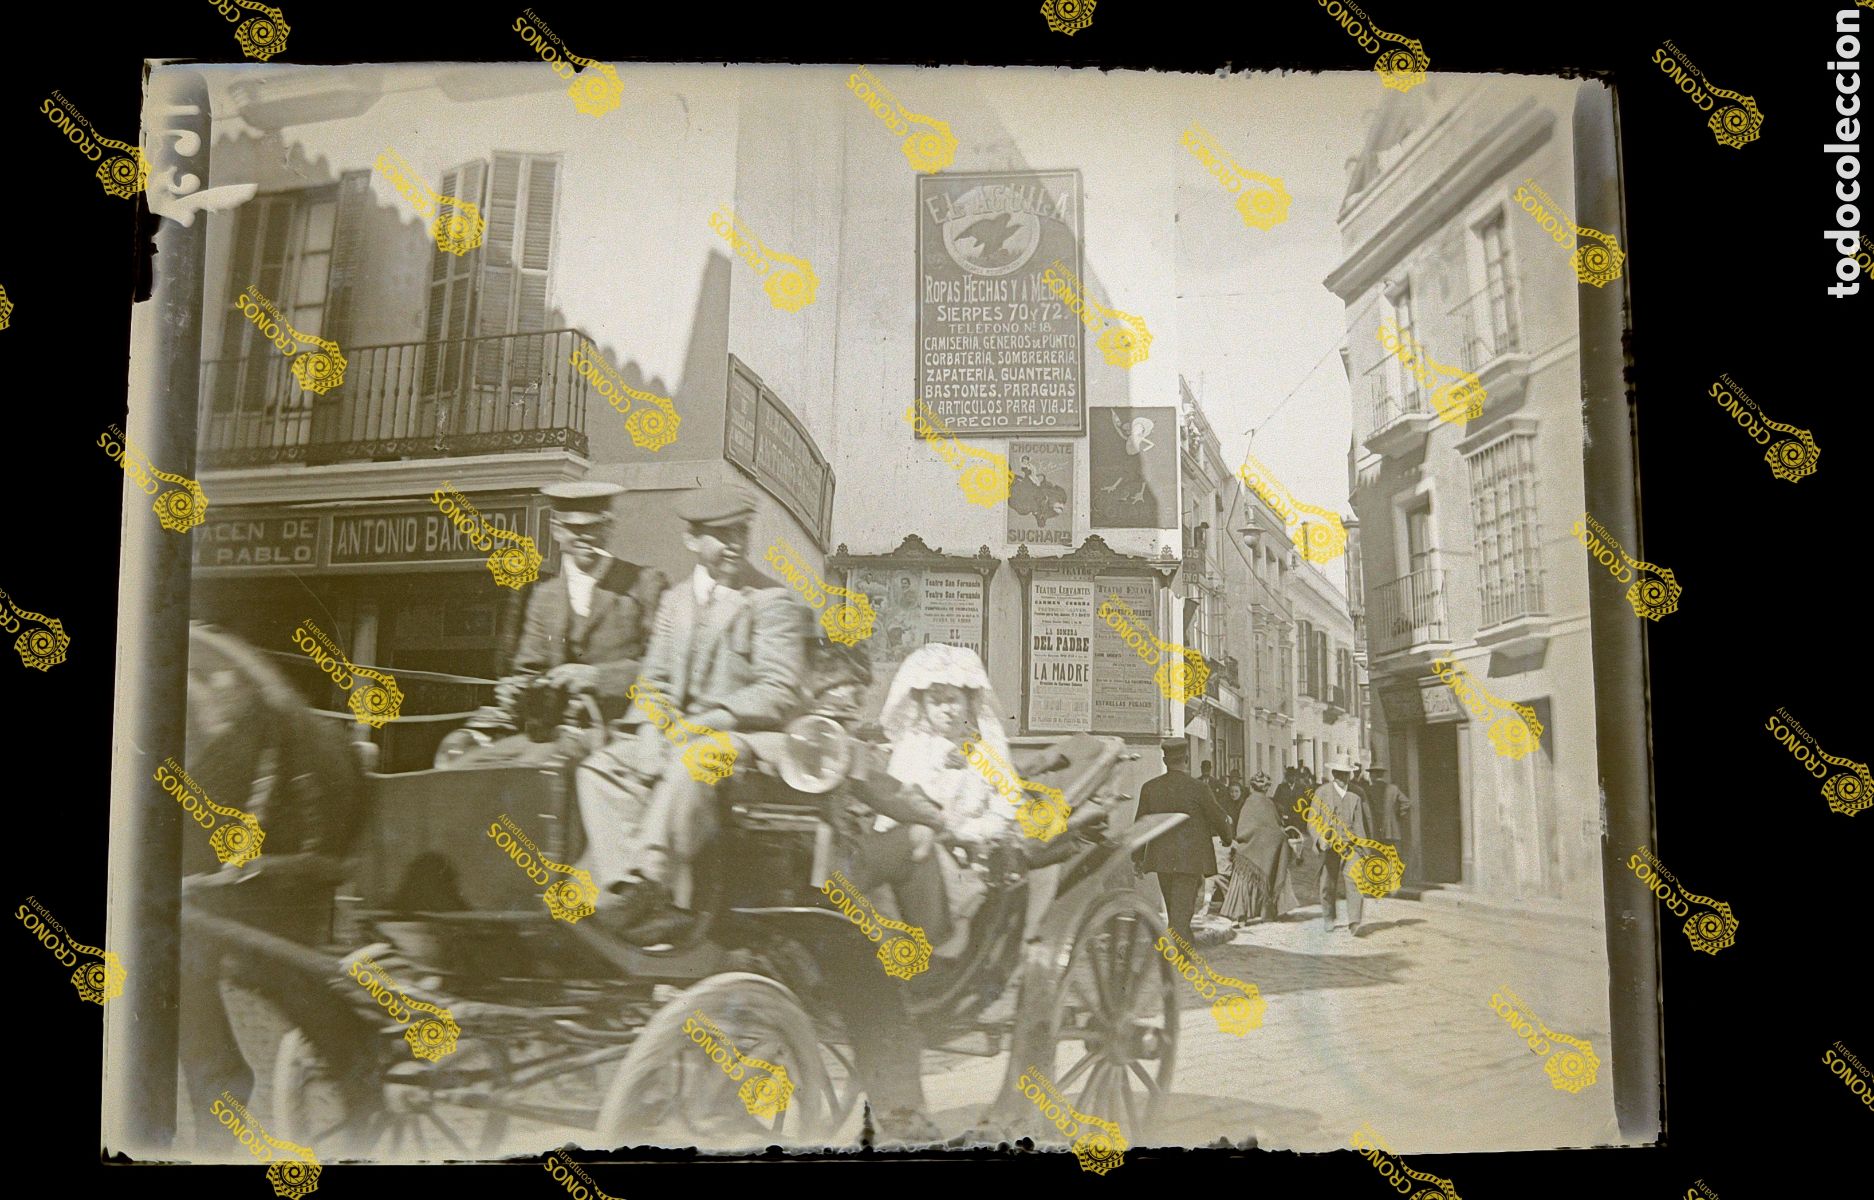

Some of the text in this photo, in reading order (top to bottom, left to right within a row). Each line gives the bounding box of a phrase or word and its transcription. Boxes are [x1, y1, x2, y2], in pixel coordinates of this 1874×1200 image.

[924, 192, 966, 225] EL
[925, 274, 960, 304] ROPAS
[962, 273, 1007, 304] HECHAS
[1011, 280, 1017, 302] Y
[1021, 280, 1027, 302] A
[937, 305, 1003, 322] SIERPES
[1008, 303, 1028, 322] 70
[1004, 383, 1075, 397] PARAGUAS
[926, 400, 933, 415] Y
[1006, 399, 1036, 414] PARA
[944, 415, 1056, 428] PRECIO FIJO
[1011, 442, 1072, 455] CHOCOLATE
[283, 521, 314, 538] DE
[337, 516, 417, 556] ANTONIO
[1009, 528, 1071, 544] SUCHARD
[217, 546, 312, 562] PABLO
[925, 578, 980, 588] Teatro San Fernando
[925, 590, 980, 599] Teatro San Fernando
[949, 629, 960, 639] EL
[1033, 635, 1089, 652] DEL PADRE
[1034, 662, 1089, 682] LA MADRE
